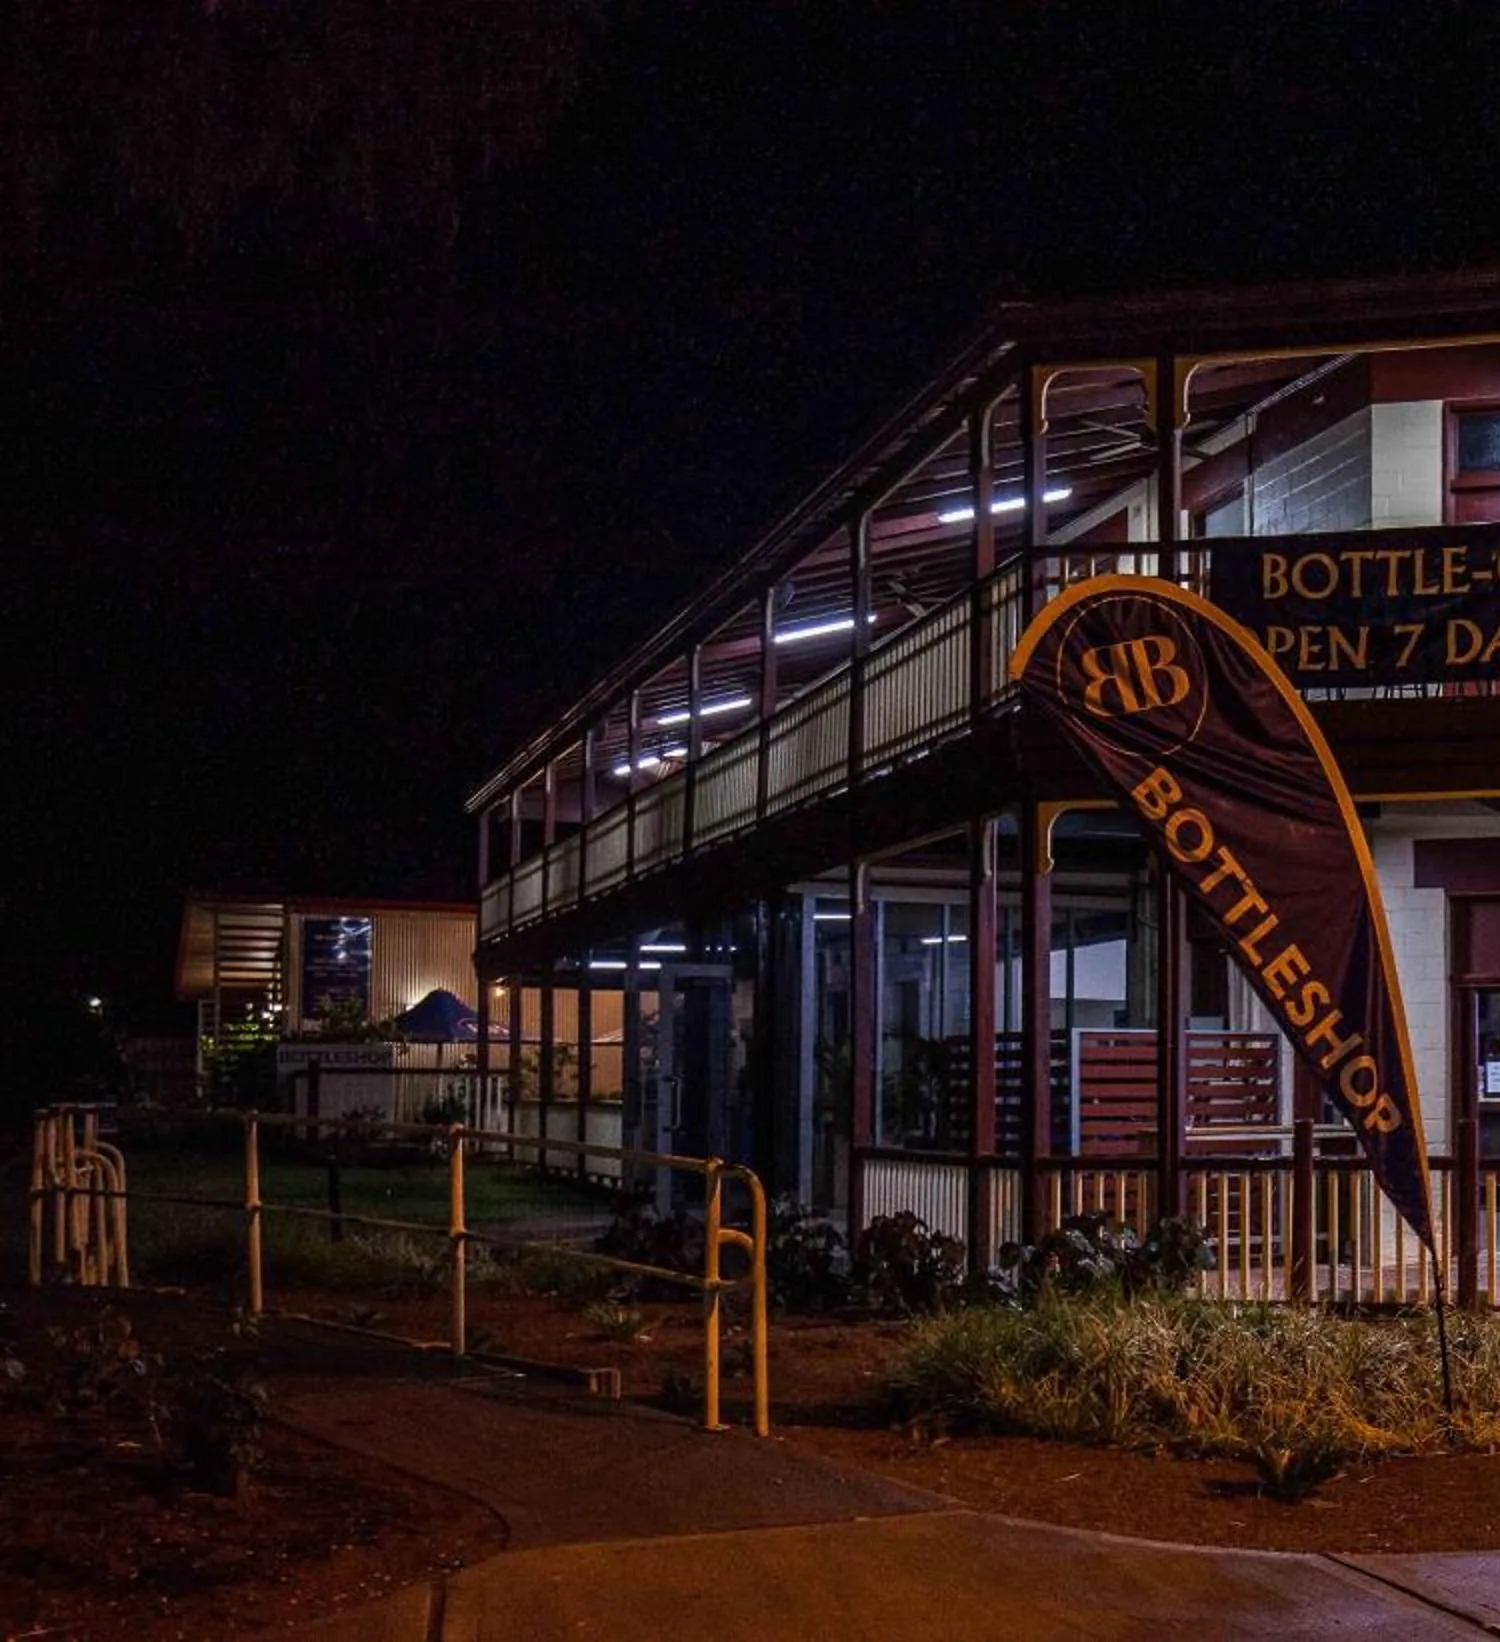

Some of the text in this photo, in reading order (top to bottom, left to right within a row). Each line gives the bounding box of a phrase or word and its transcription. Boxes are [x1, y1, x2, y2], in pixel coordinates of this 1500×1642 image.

[1243, 624, 1370, 671] PEN
[1393, 623, 1425, 667] 7
[1131, 766, 1402, 1134] BOTTLESHOP
